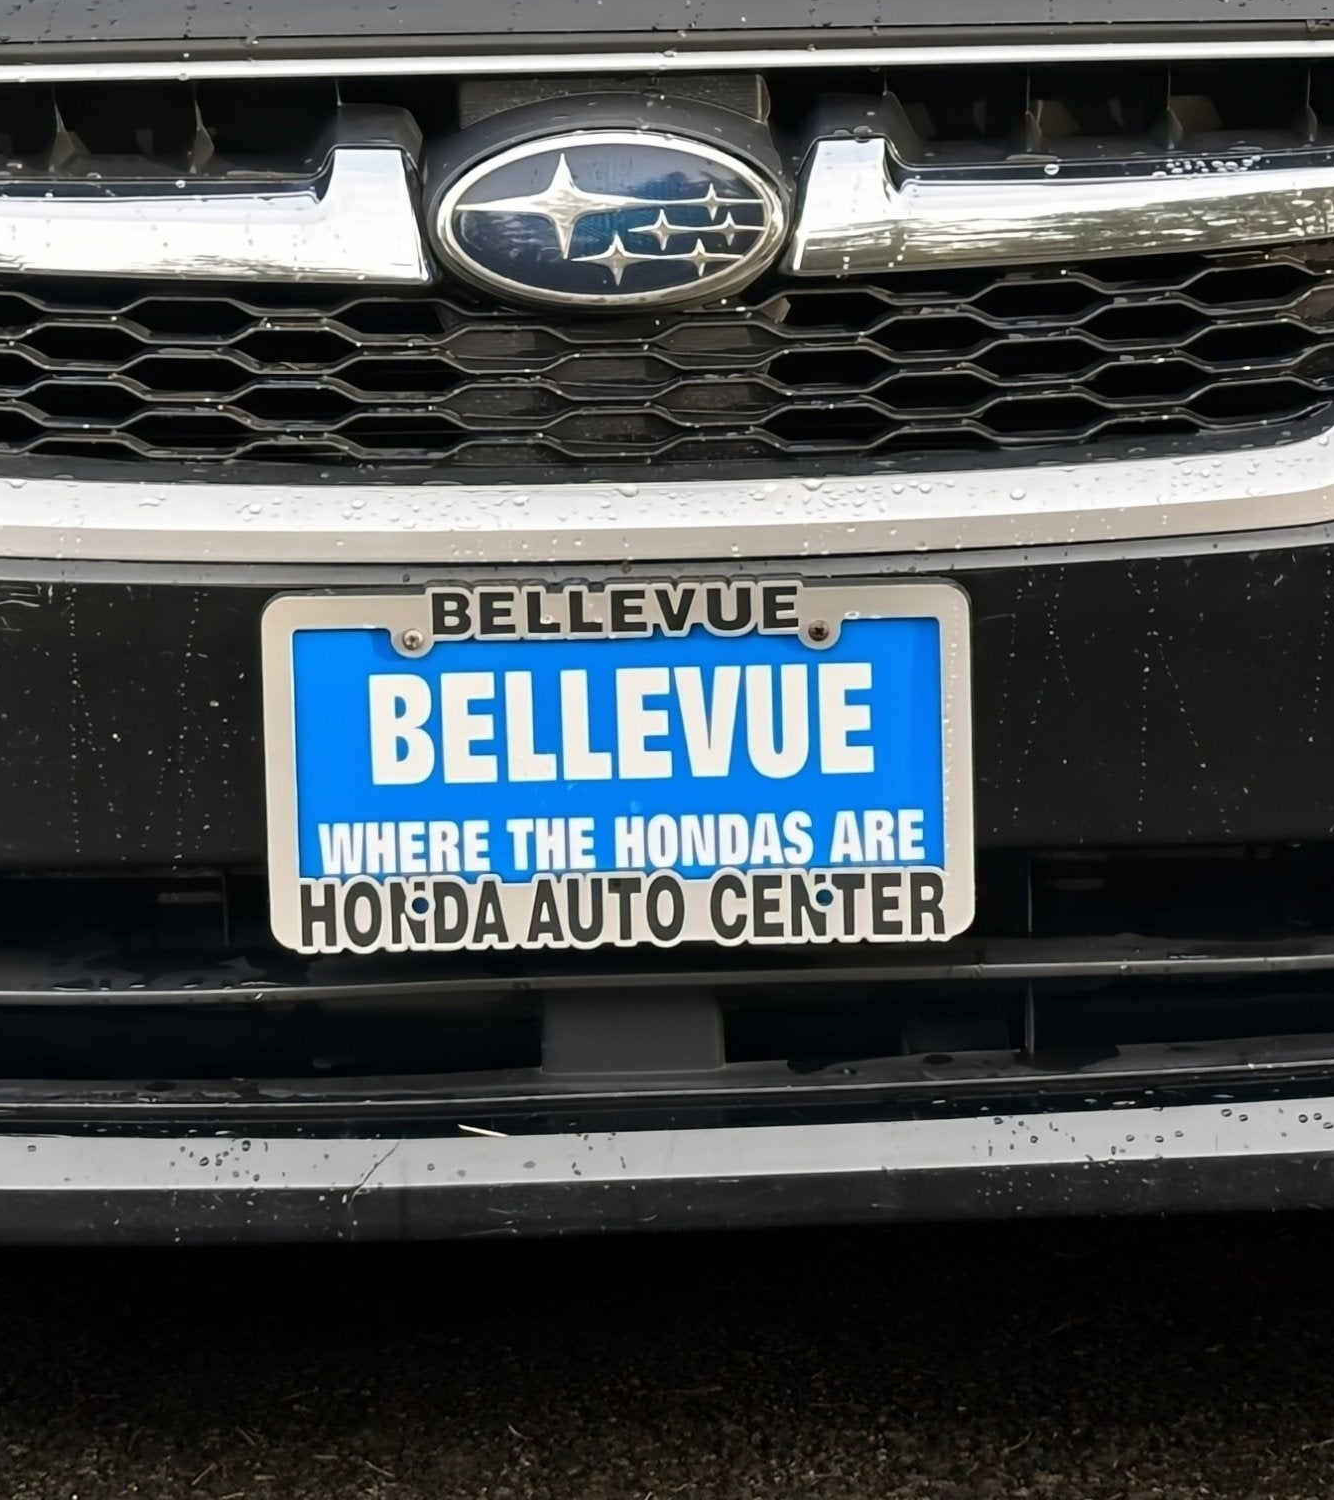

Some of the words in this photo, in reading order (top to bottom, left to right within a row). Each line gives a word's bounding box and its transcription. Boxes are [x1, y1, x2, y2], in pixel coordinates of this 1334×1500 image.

[431, 586, 799, 636] BELLEVUE
[368, 662, 875, 786] BELLEVUE
[318, 821, 490, 876] WHERE
[507, 816, 597, 871] THE
[615, 810, 814, 868] HONDAS
[830, 809, 926, 862] ARE
[300, 879, 509, 947] HONDA
[527, 876, 686, 944] AUTO
[710, 872, 946, 941] CENTER
